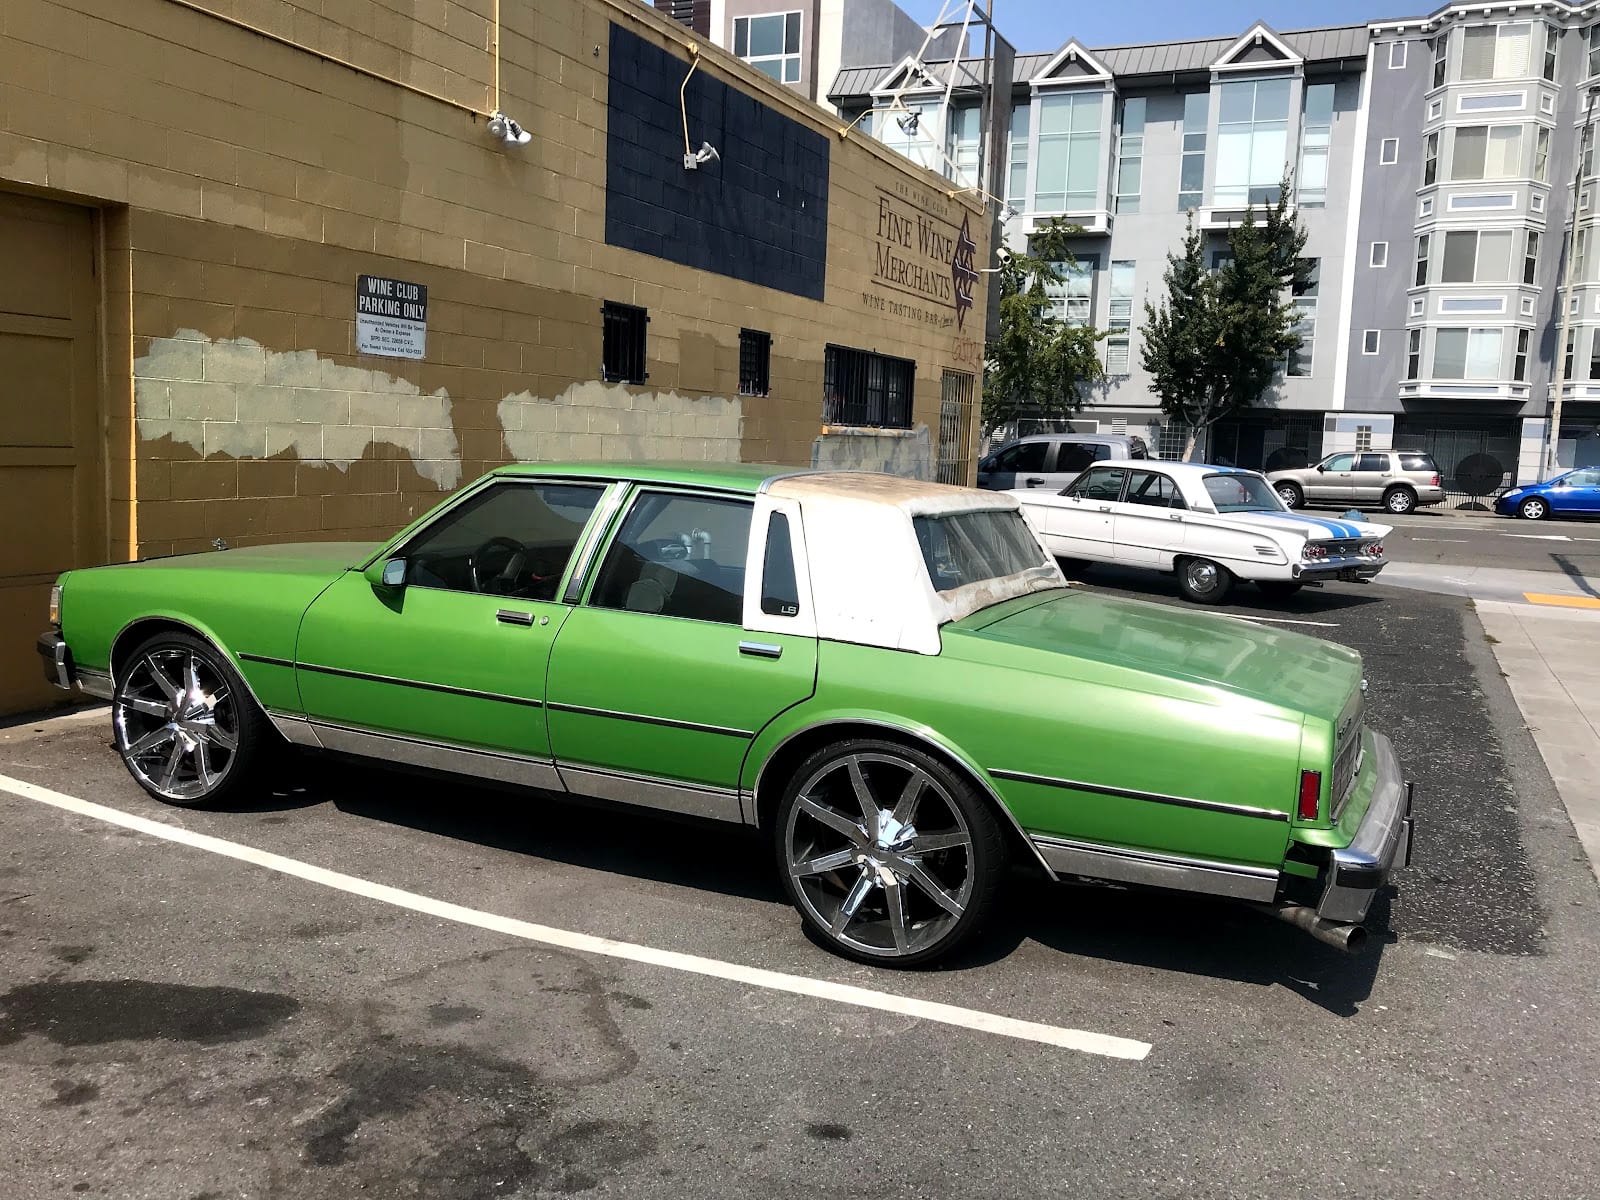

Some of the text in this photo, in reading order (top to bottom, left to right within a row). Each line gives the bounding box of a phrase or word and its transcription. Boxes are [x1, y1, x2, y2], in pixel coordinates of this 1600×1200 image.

[932, 201, 948, 216] CLUB
[876, 196, 953, 266] FINE WINE
[874, 241, 951, 301] MERCHANTS
[368, 277, 418, 300] WINE CLUB
[360, 295, 424, 320] PARKING ONLY
[862, 292, 886, 311] WINE
[888, 300, 922, 321] TASTING
[781, 605, 797, 615] LS
